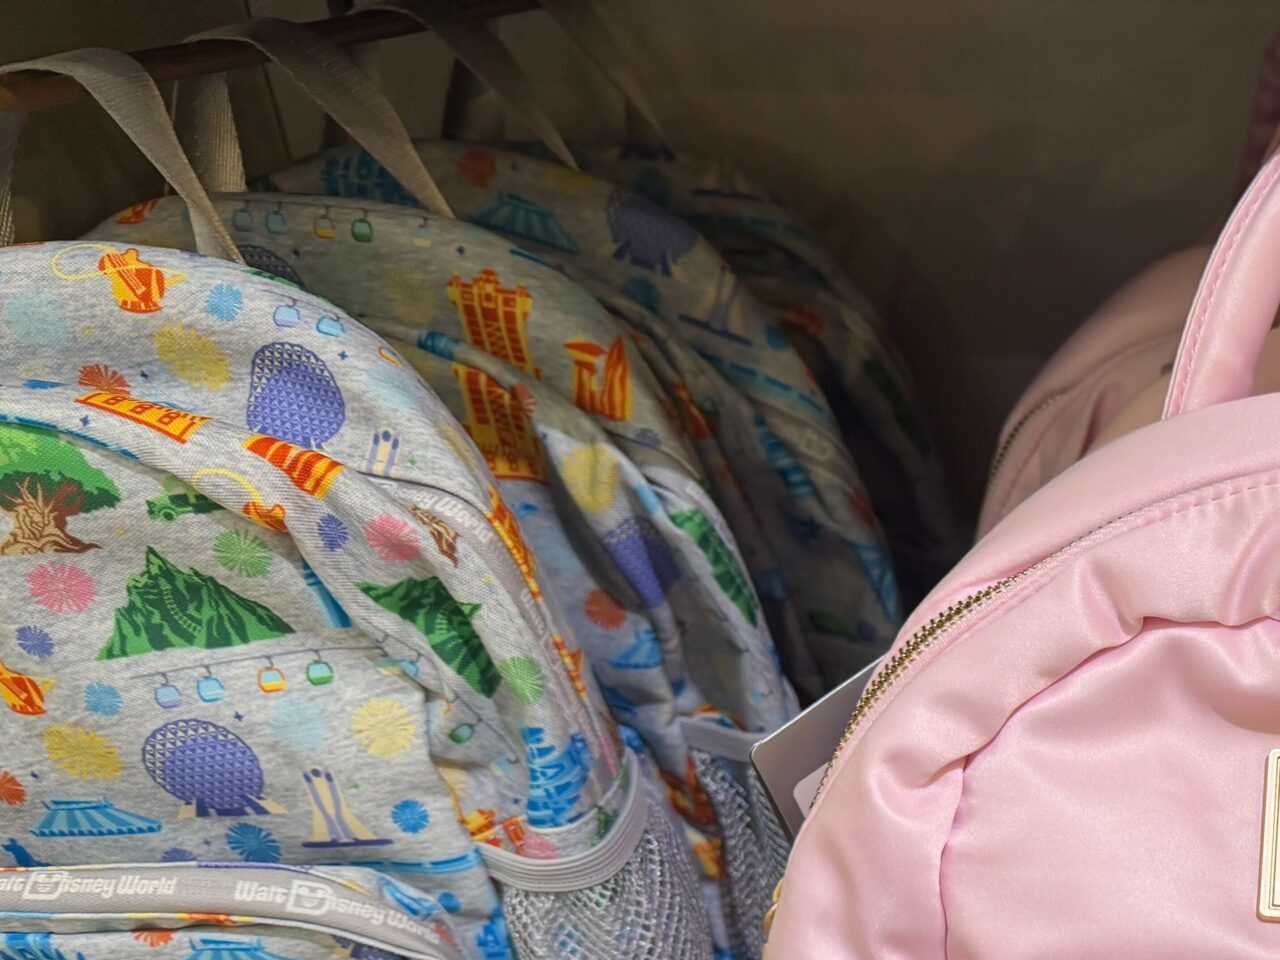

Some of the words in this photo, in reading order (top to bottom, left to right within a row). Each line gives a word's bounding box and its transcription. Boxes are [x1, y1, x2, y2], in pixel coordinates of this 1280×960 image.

[0, 875, 26, 893] alt
[22, 870, 117, 900] Disney
[116, 874, 178, 896] World
[234, 880, 289, 903] Walt
[286, 879, 387, 926] Disney
[385, 908, 440, 945] World
